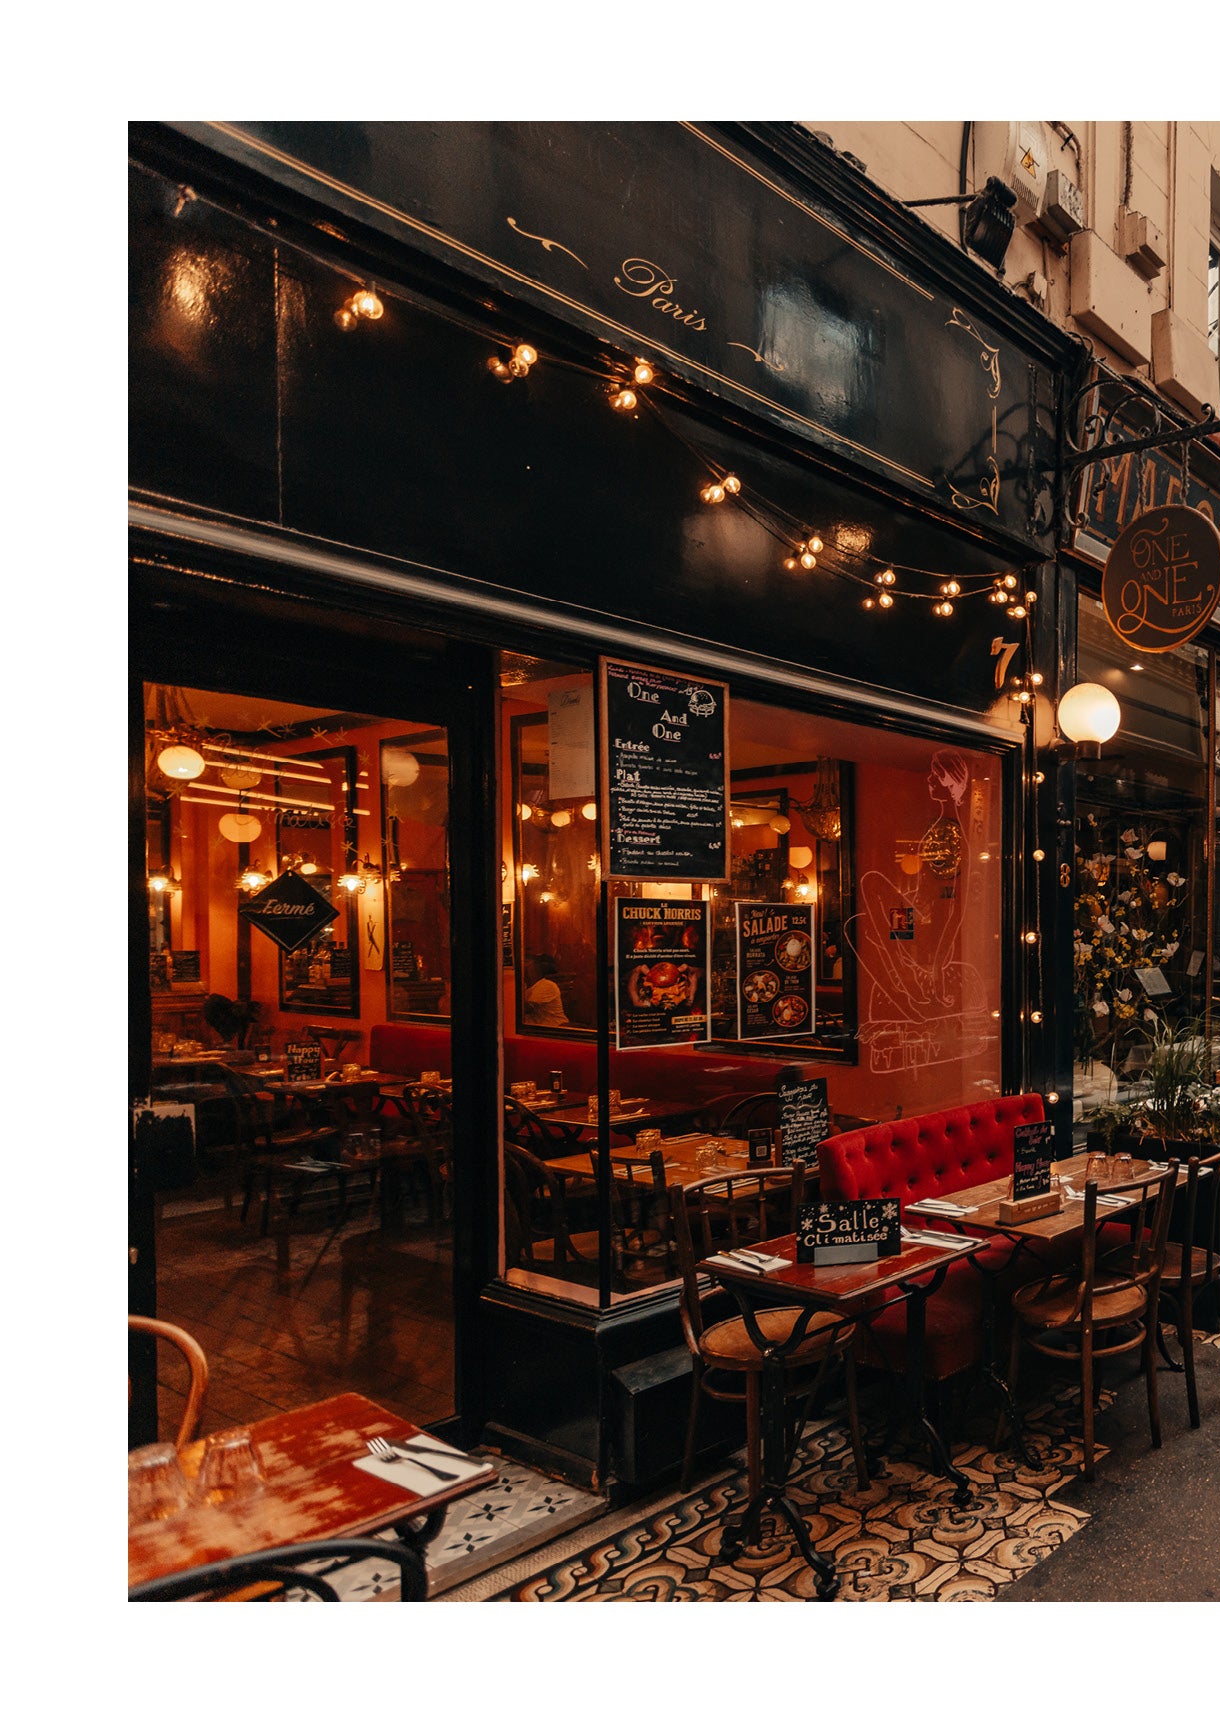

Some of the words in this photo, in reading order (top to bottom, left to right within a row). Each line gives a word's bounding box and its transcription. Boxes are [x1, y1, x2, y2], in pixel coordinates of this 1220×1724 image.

[613, 257, 707, 332] Paris
[1130, 520, 1190, 569] ONE
[1119, 561, 1204, 618] ONE
[1171, 603, 1202, 617] PARIS
[990, 636, 1020, 689] 7
[627, 681, 659, 702] One
[660, 709, 688, 726] And
[652, 723, 682, 740] One
[614, 738, 650, 752] Entrée
[616, 768, 641, 783] Plat
[617, 833, 661, 845] Dessert
[1059, 862, 1071, 889] 8
[261, 898, 315, 916] Fermé
[622, 906, 661, 920] CHUCK
[664, 907, 702, 921] NORRIS
[743, 914, 788, 938] SALADE
[816, 1208, 880, 1234] Salle
[803, 1229, 888, 1247] Climatisée
